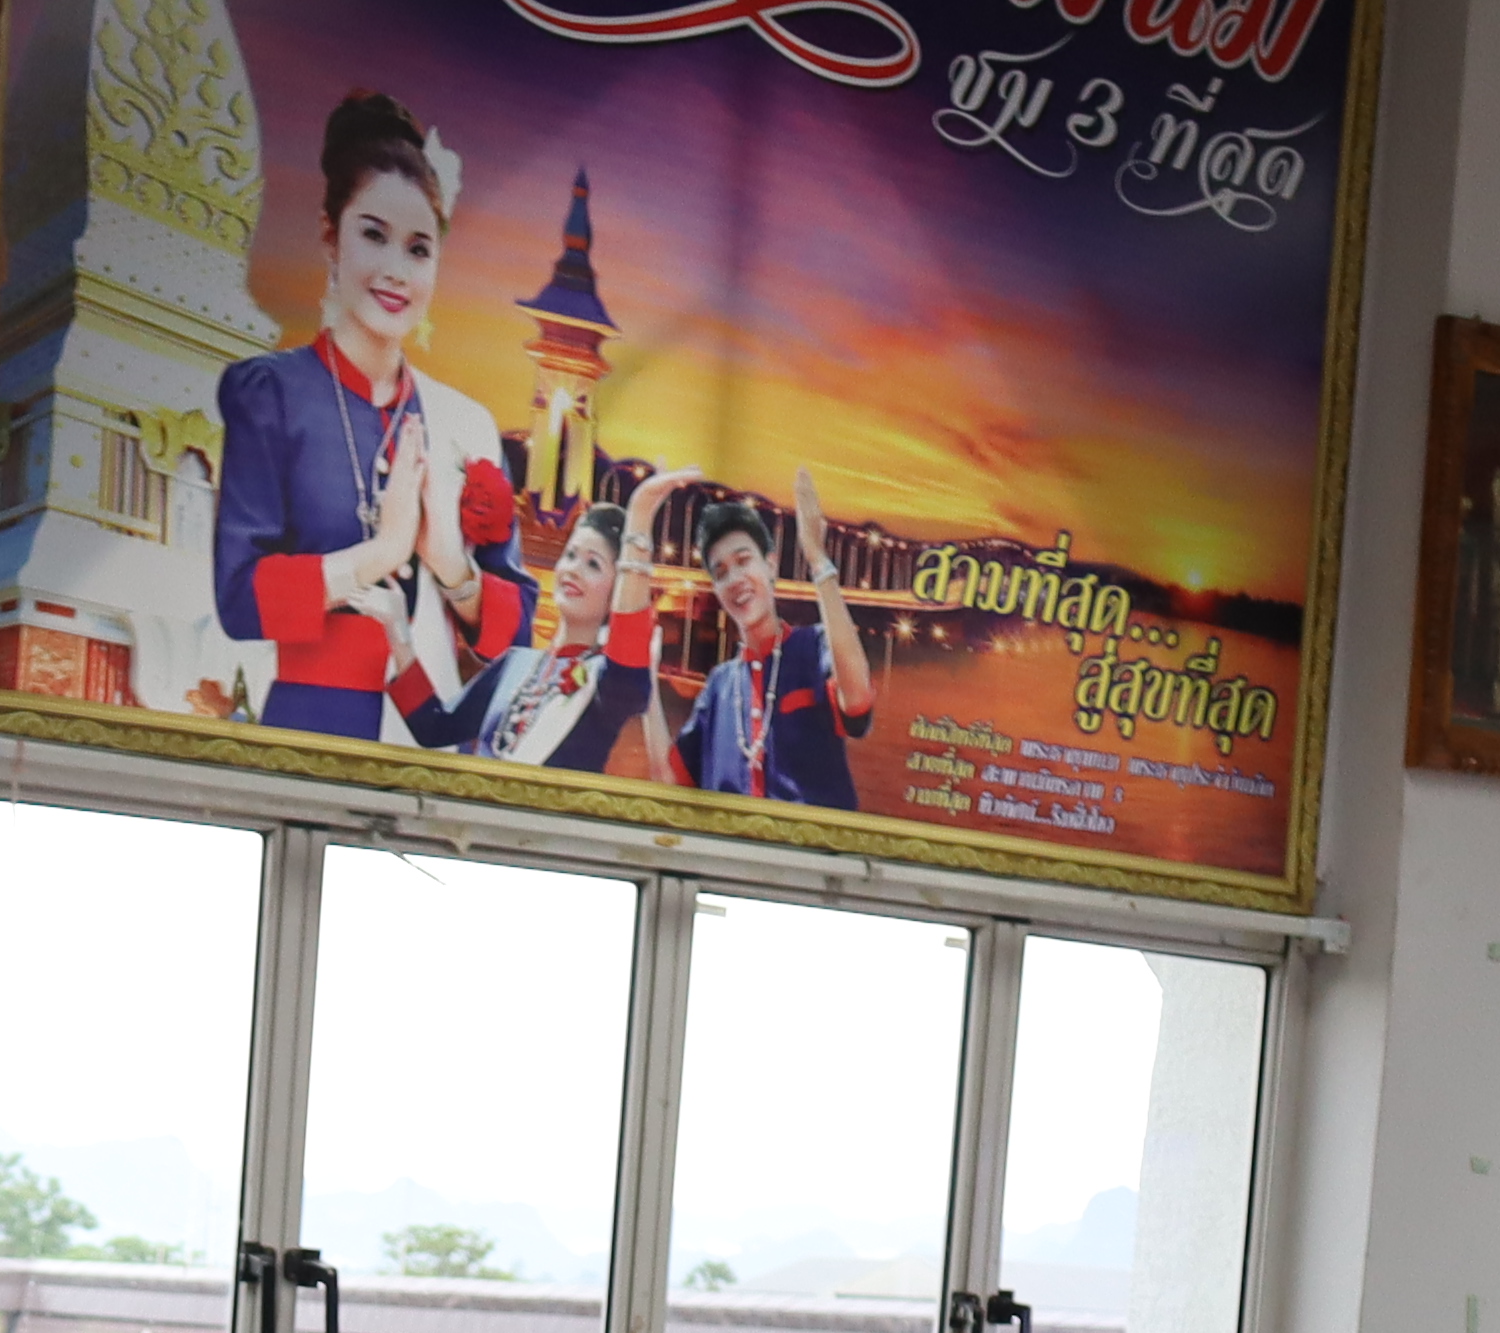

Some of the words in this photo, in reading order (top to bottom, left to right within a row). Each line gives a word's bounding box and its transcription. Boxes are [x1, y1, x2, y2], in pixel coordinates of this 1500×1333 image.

[1067, 78, 1125, 147] 3
[1116, 77, 1312, 231] ที่สุด
